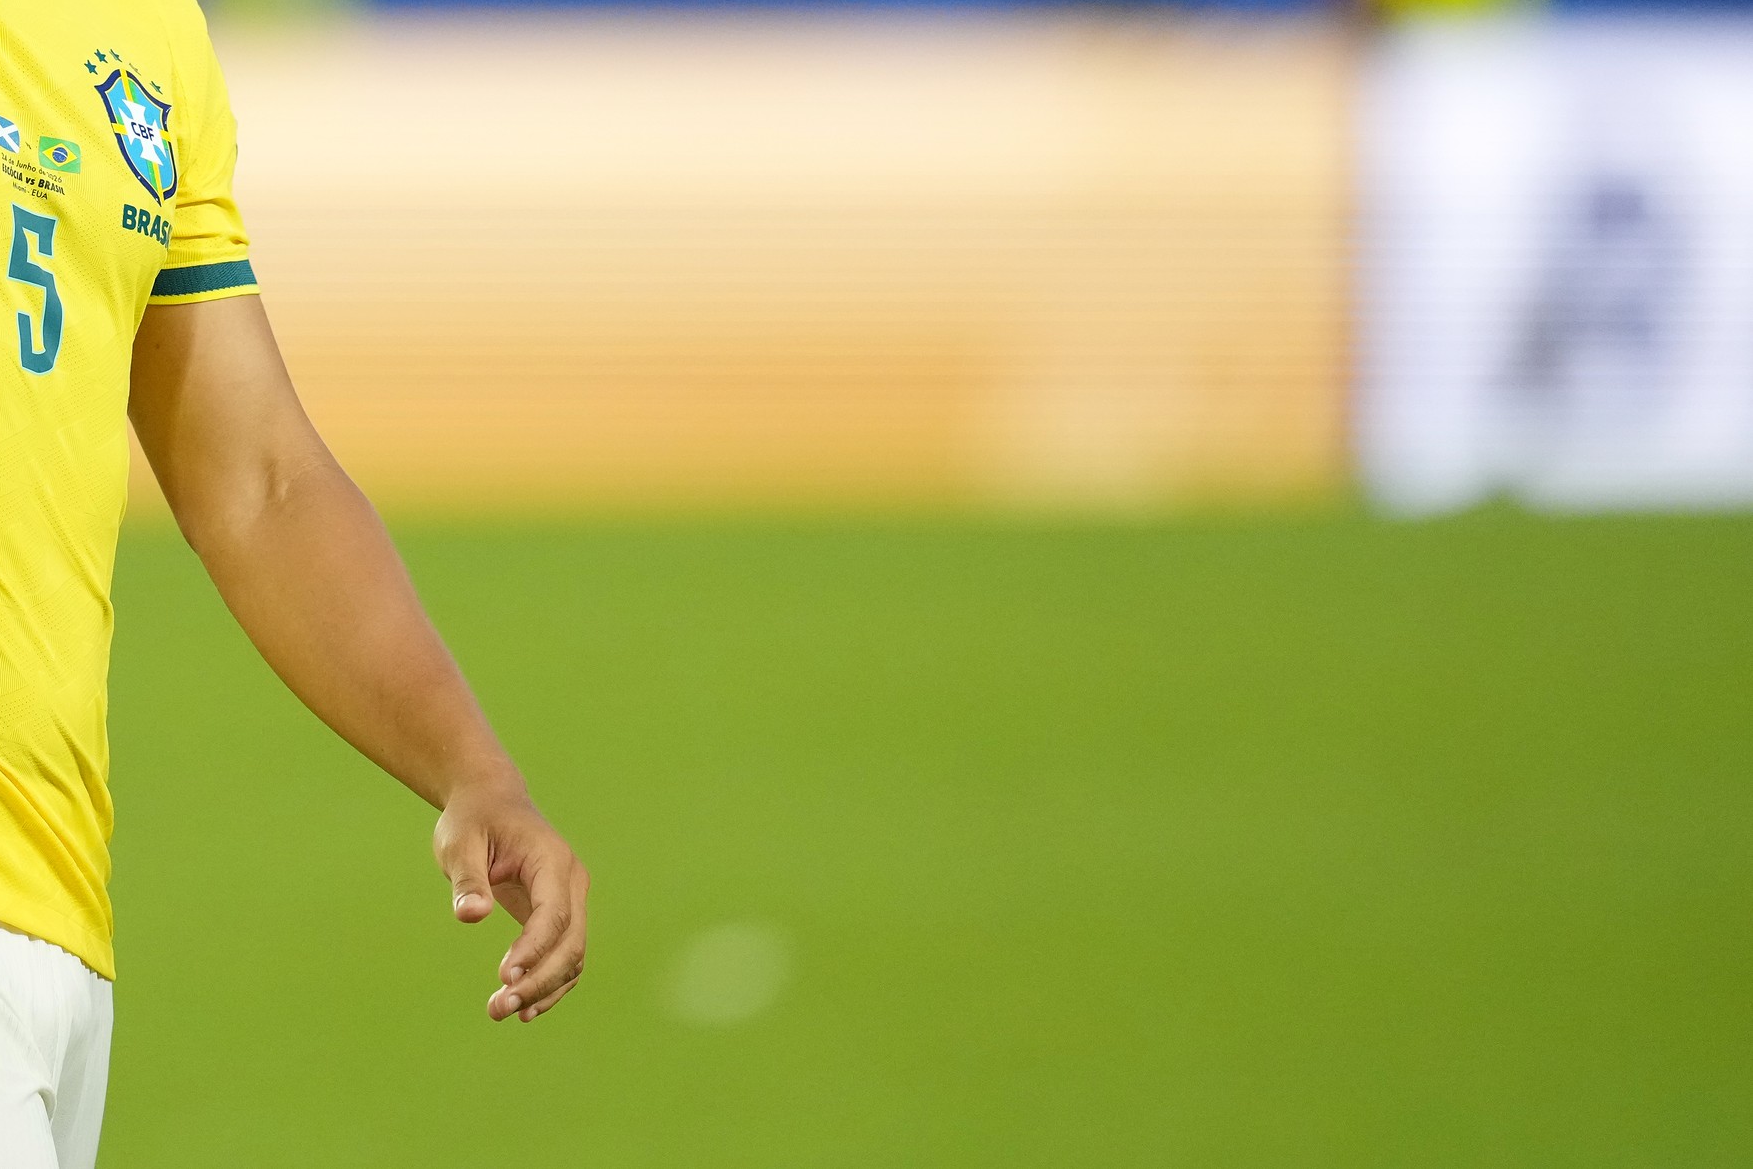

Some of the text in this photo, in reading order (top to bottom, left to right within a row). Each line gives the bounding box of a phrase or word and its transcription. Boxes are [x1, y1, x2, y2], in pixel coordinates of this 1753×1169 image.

[131, 121, 155, 142] CBF
[16, 160, 37, 172] Junho
[25, 177, 36, 186] vs
[38, 178, 65, 196] BRASIL
[31, 188, 48, 200] EUA
[122, 203, 173, 250] BRASI
[7, 202, 65, 375] 5
